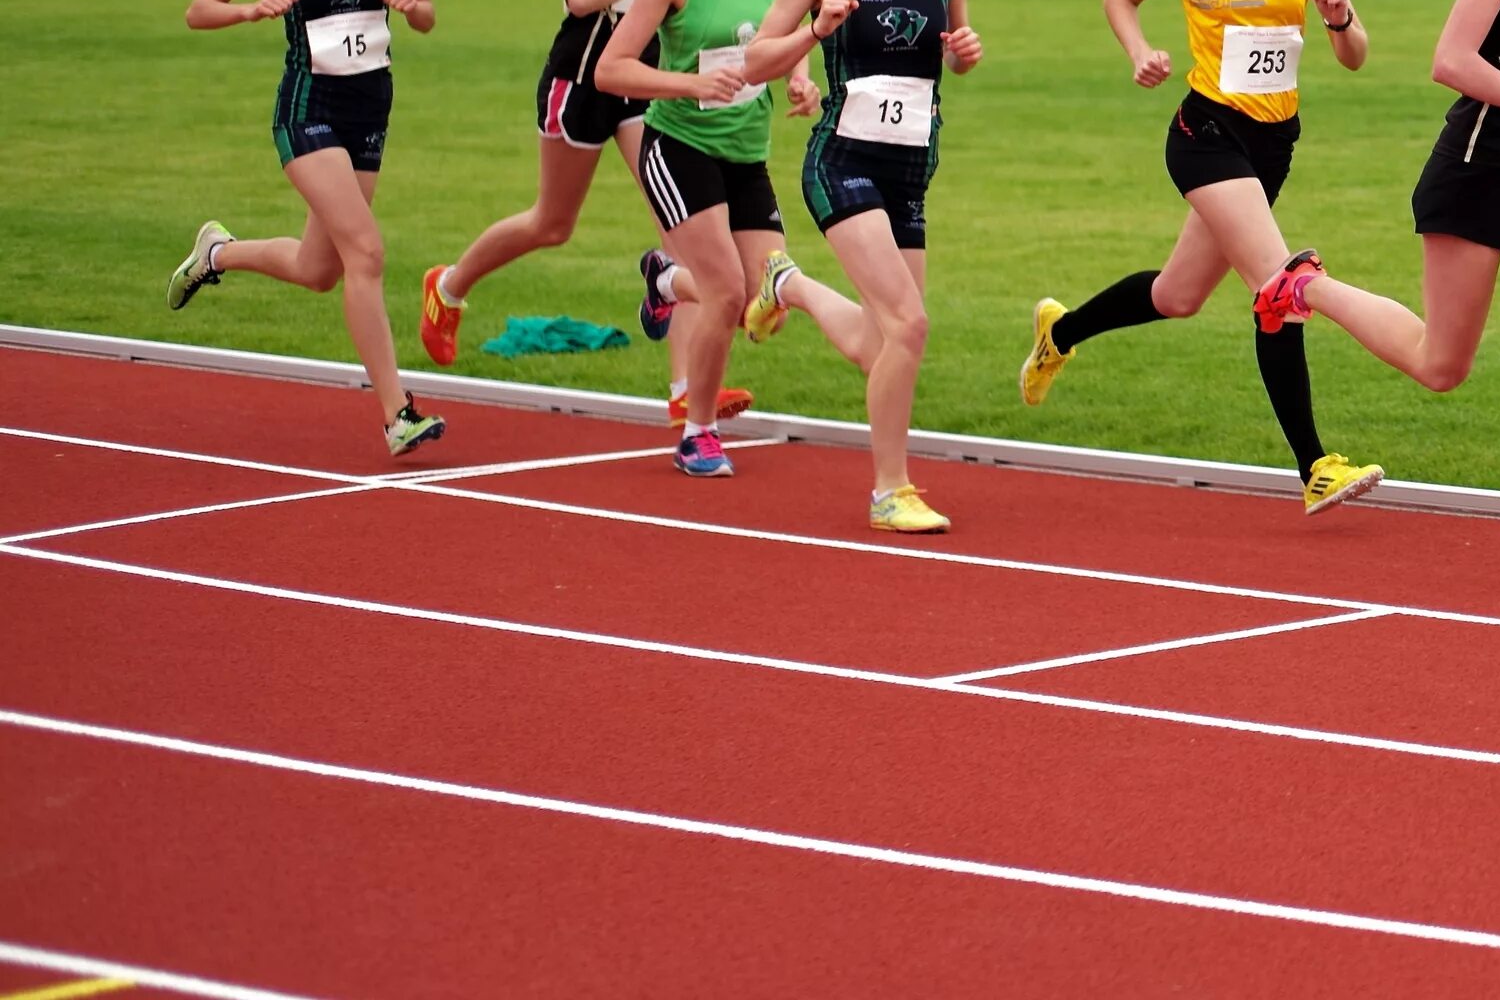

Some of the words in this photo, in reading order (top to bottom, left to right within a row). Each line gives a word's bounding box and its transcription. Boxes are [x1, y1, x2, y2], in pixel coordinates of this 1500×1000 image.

[342, 34, 367, 57] 15
[1247, 49, 1286, 74] 253
[879, 99, 903, 124] 13
